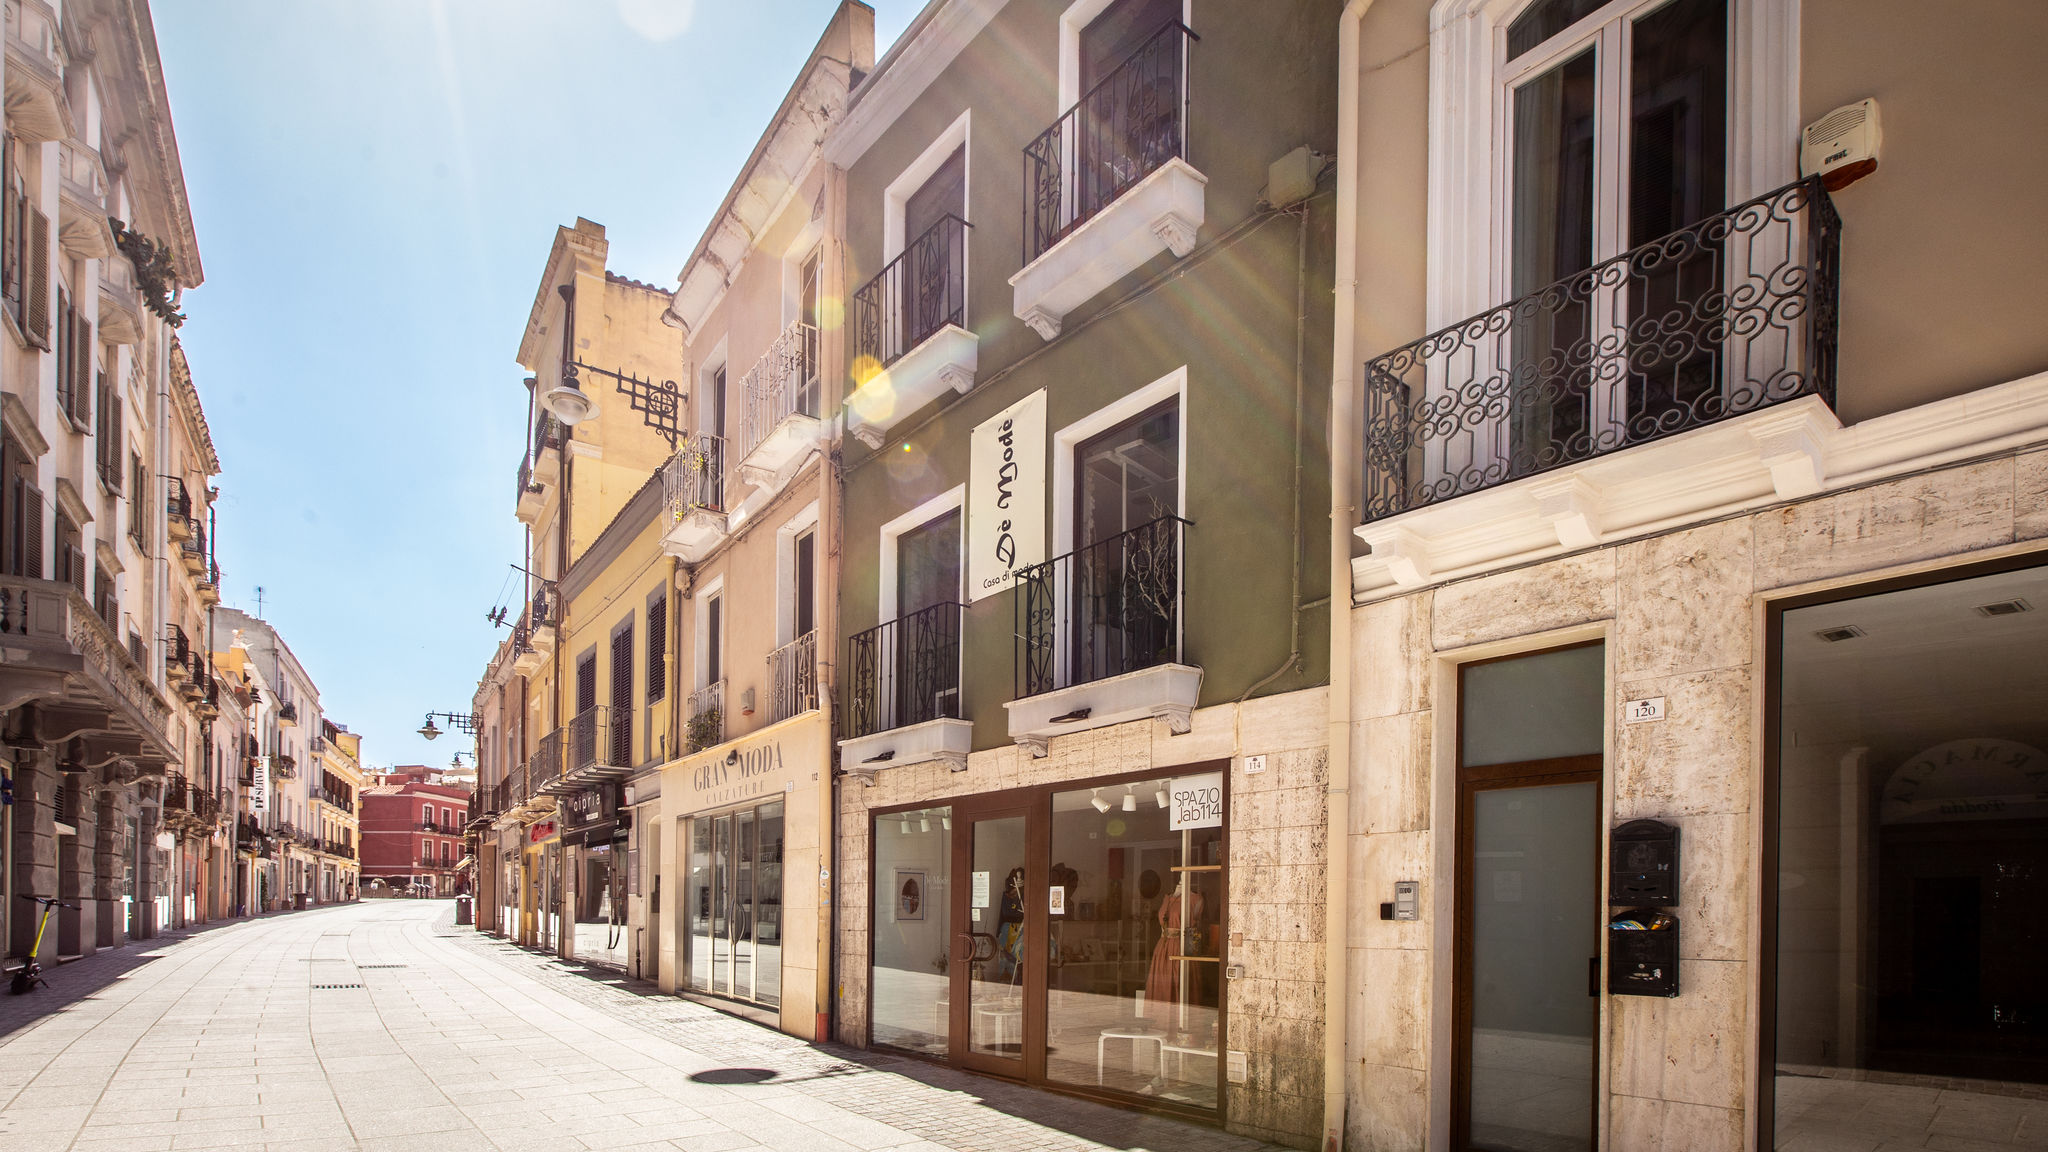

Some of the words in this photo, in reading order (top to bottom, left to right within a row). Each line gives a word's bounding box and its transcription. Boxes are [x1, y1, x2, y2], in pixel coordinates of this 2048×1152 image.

[1002, 570, 1010, 582] di
[1635, 706, 1655, 717] 120
[694, 760, 730, 792] GRAN
[738, 741, 783, 780] MODA
[1249, 761, 1261, 770] 114
[573, 792, 600, 812] cipria
[1174, 787, 1220, 807] SPAZIO
